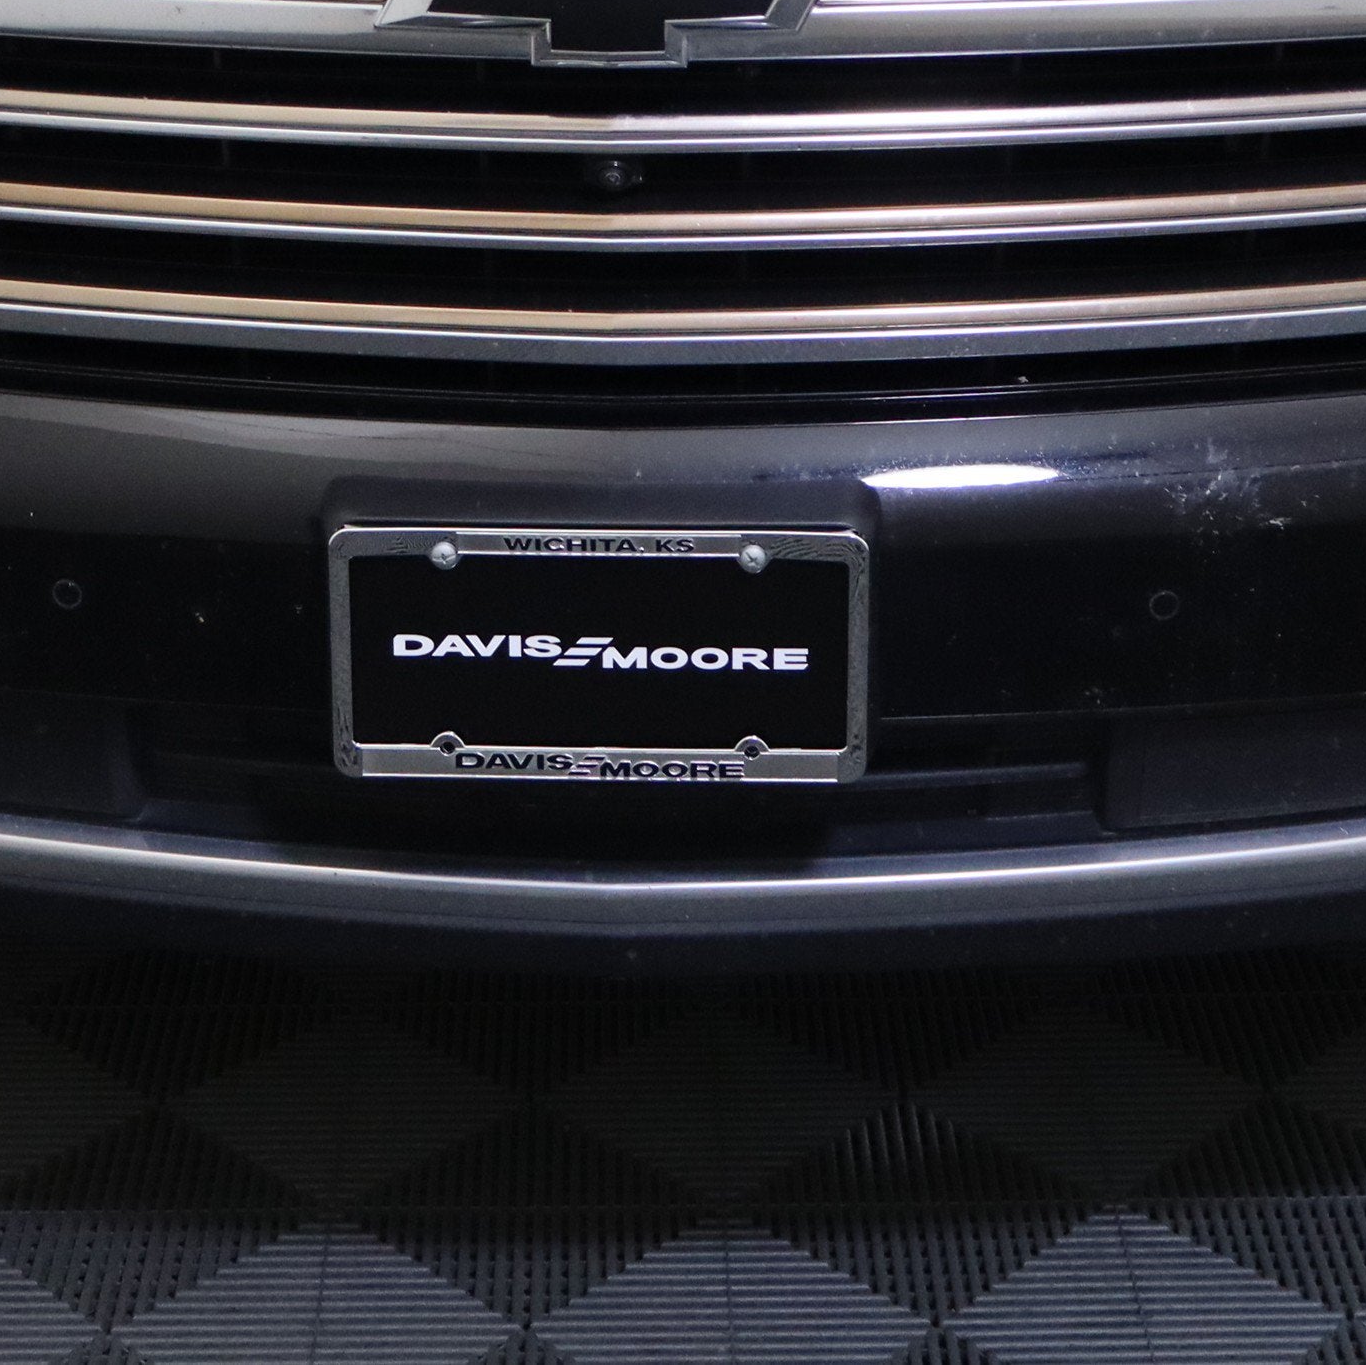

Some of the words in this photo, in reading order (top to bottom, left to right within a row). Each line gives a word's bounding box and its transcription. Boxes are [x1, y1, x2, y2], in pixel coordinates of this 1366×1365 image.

[655, 539, 695, 553] KS
[392, 633, 564, 658] DAVIS
[601, 645, 810, 671] MOORE
[455, 751, 574, 771] DAVIS
[600, 759, 745, 779] MOORE
